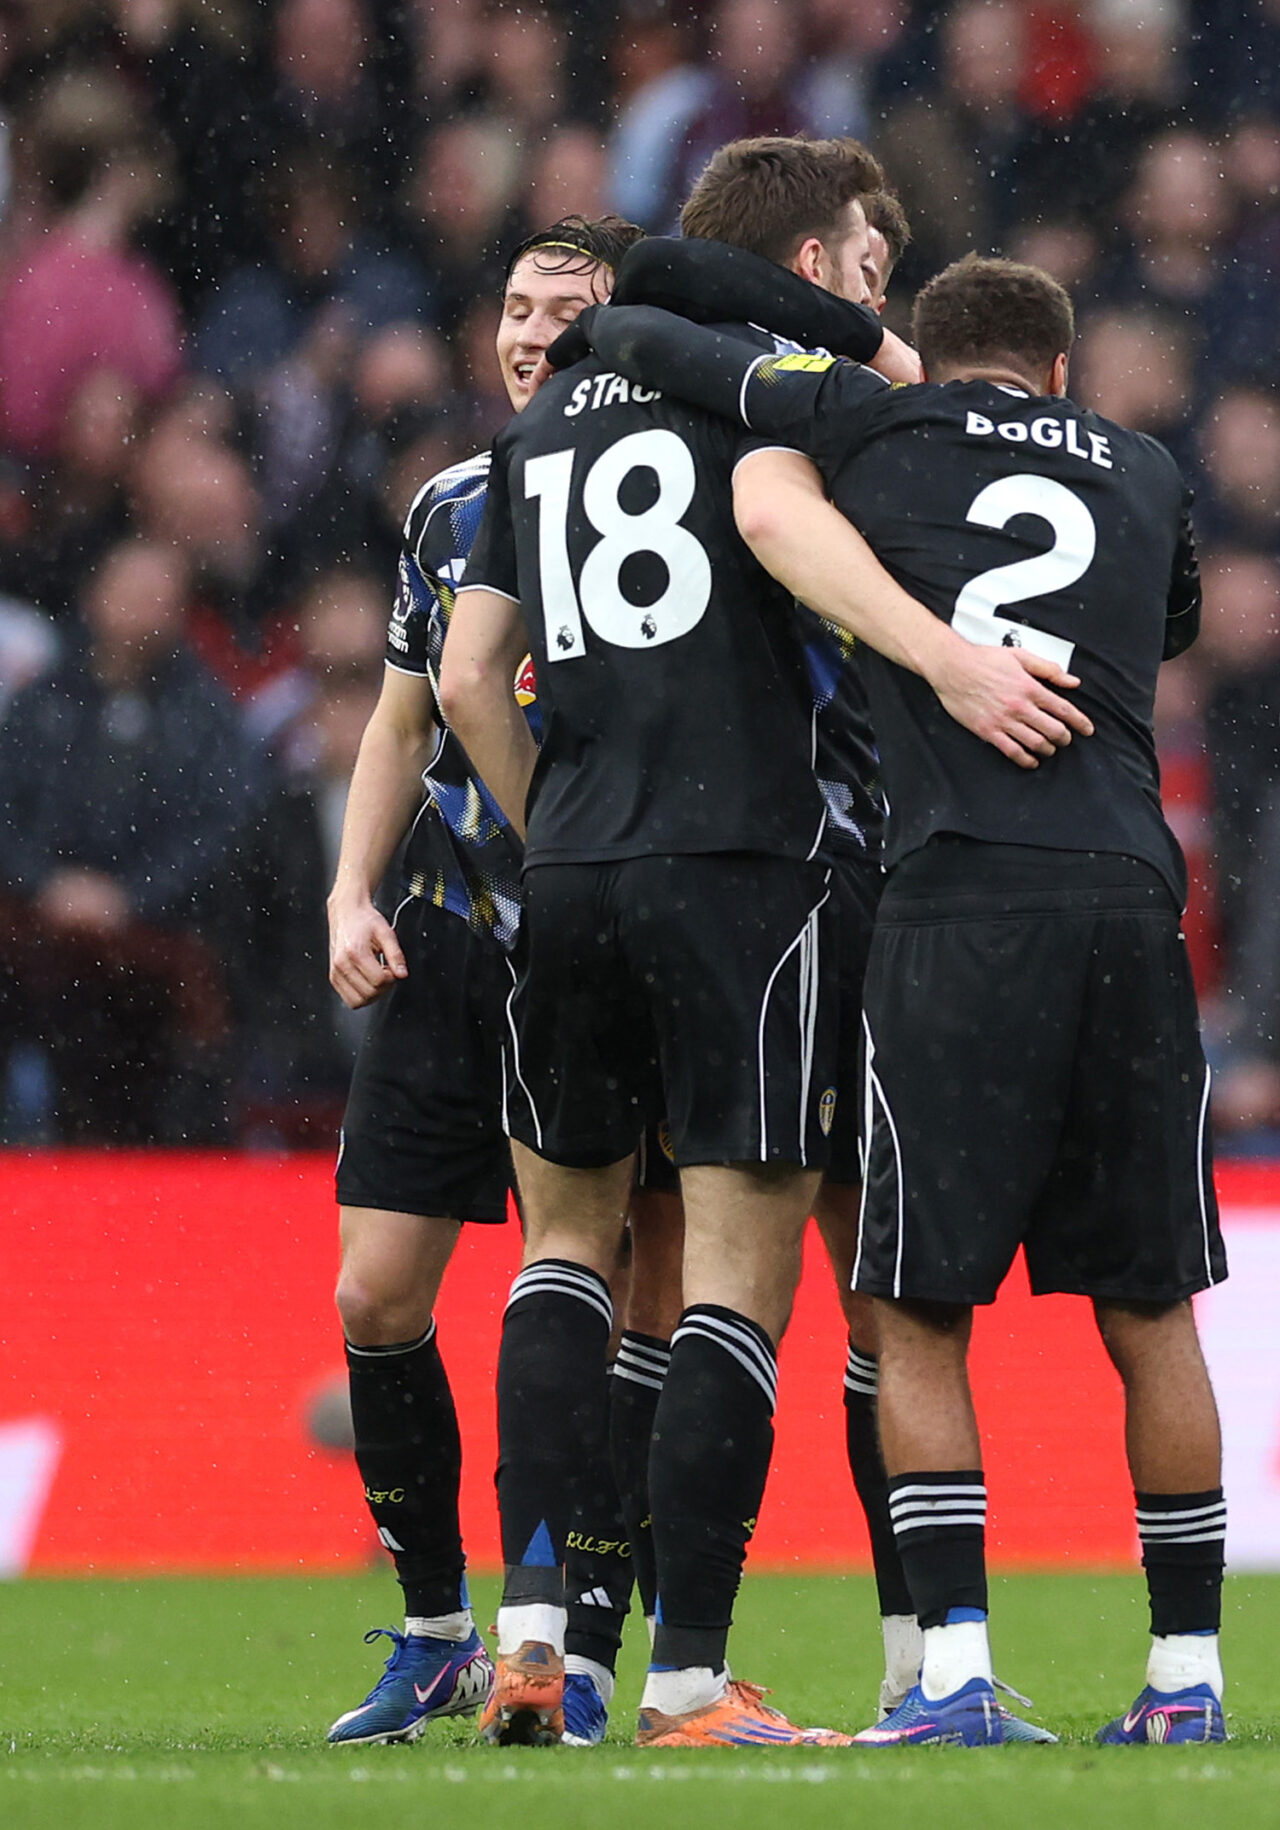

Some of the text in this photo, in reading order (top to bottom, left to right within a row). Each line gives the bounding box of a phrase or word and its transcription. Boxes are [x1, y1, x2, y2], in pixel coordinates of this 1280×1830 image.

[563, 372, 663, 416] STAC
[965, 410, 1113, 470] BOGLE
[524, 428, 713, 663] 18
[950, 472, 1097, 674] 2
